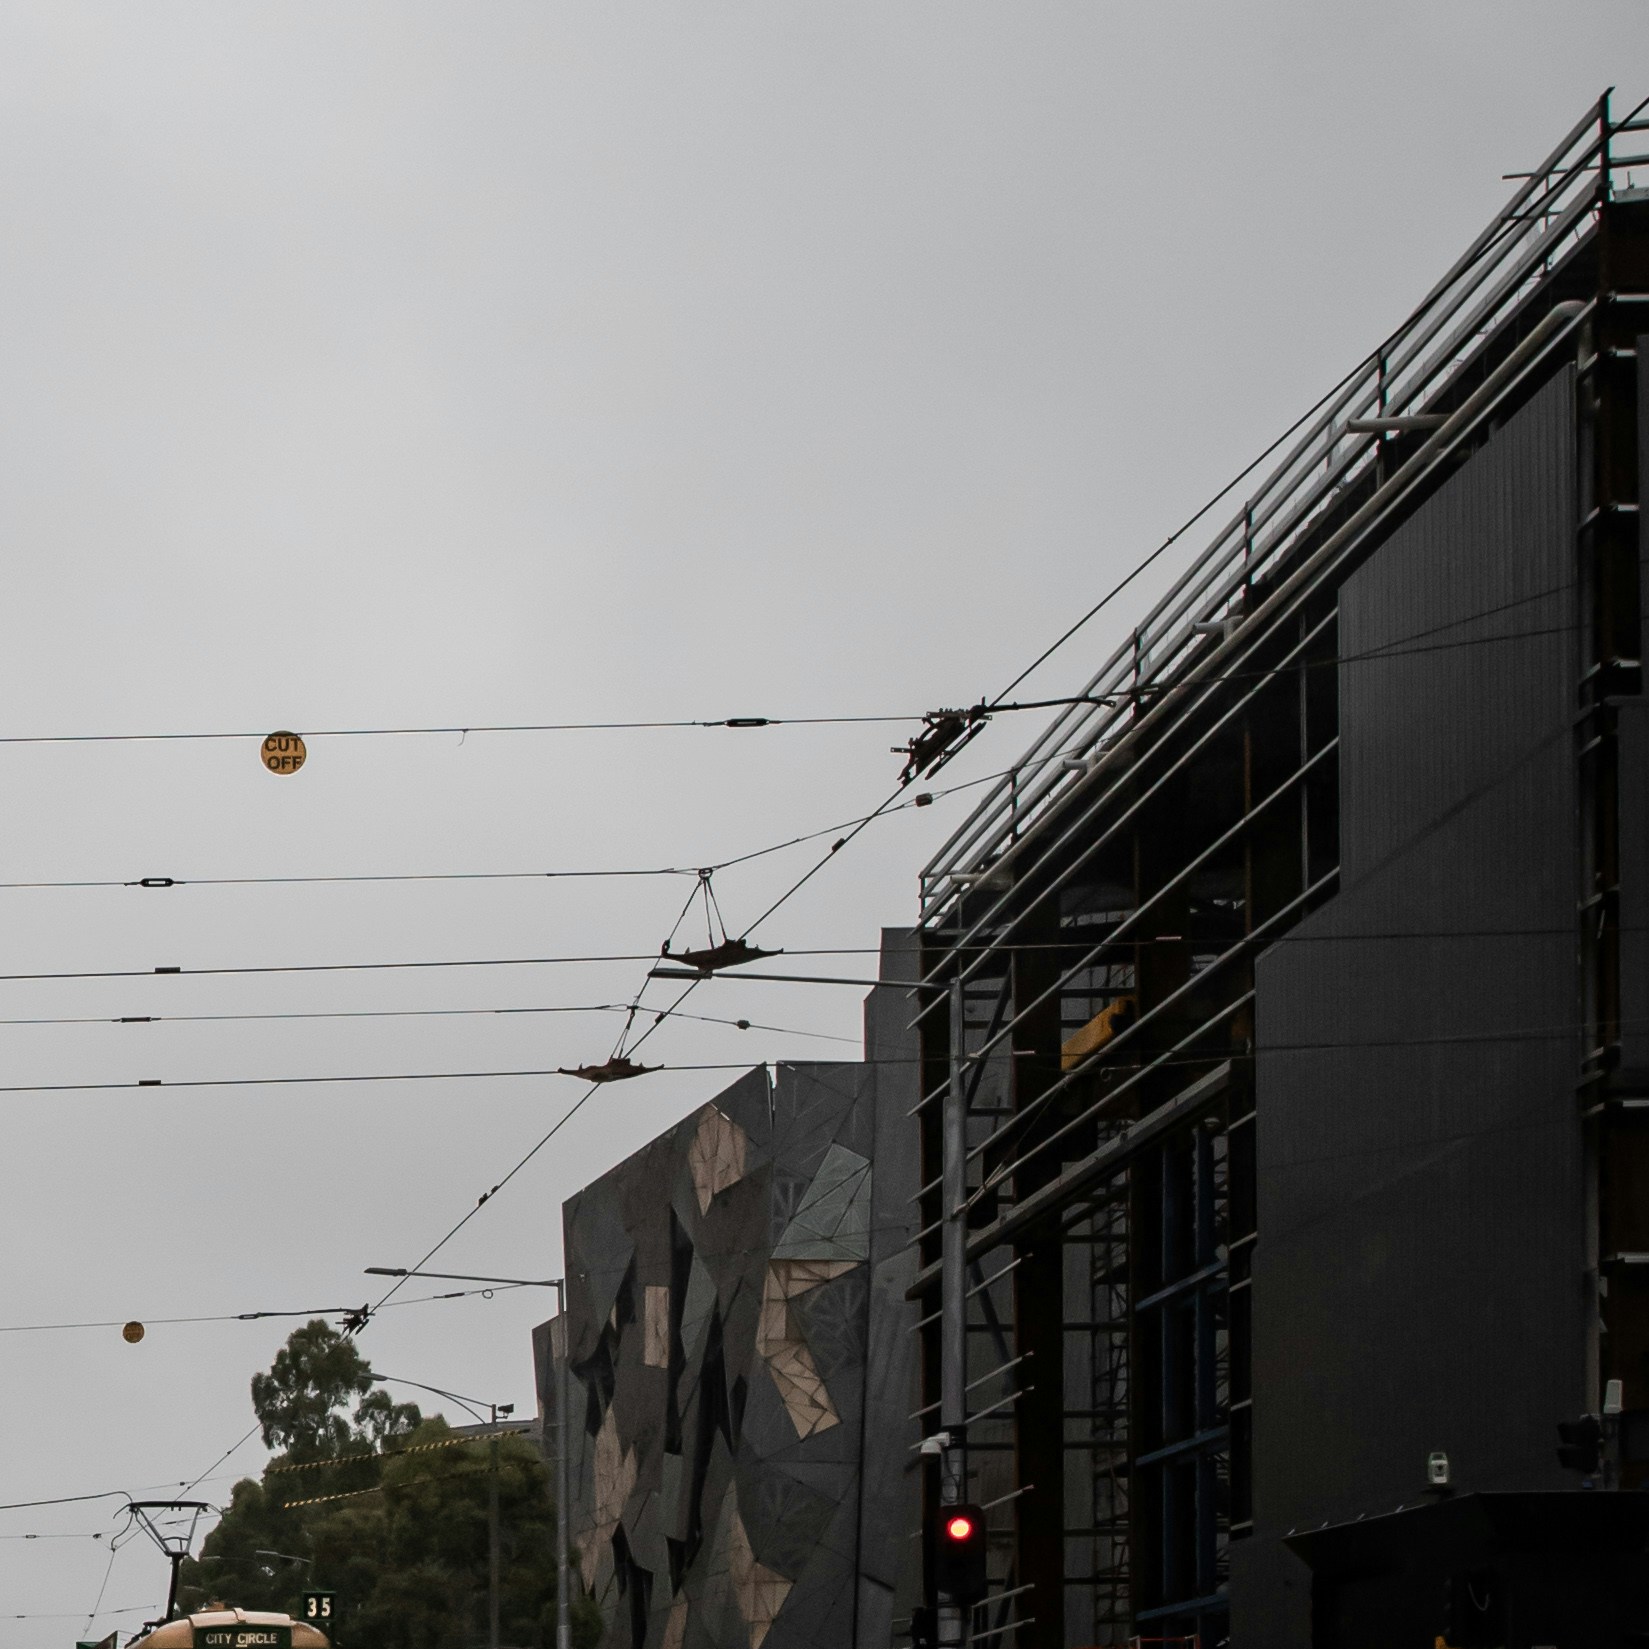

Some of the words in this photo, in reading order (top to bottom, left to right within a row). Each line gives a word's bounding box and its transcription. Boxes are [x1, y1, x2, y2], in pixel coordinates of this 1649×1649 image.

[265, 738, 299, 752] CUT
[267, 756, 302, 770] OFF
[308, 1597, 332, 1618] 35
[206, 1633, 232, 1645] CITY
[237, 1633, 277, 1644] CIRCLE
